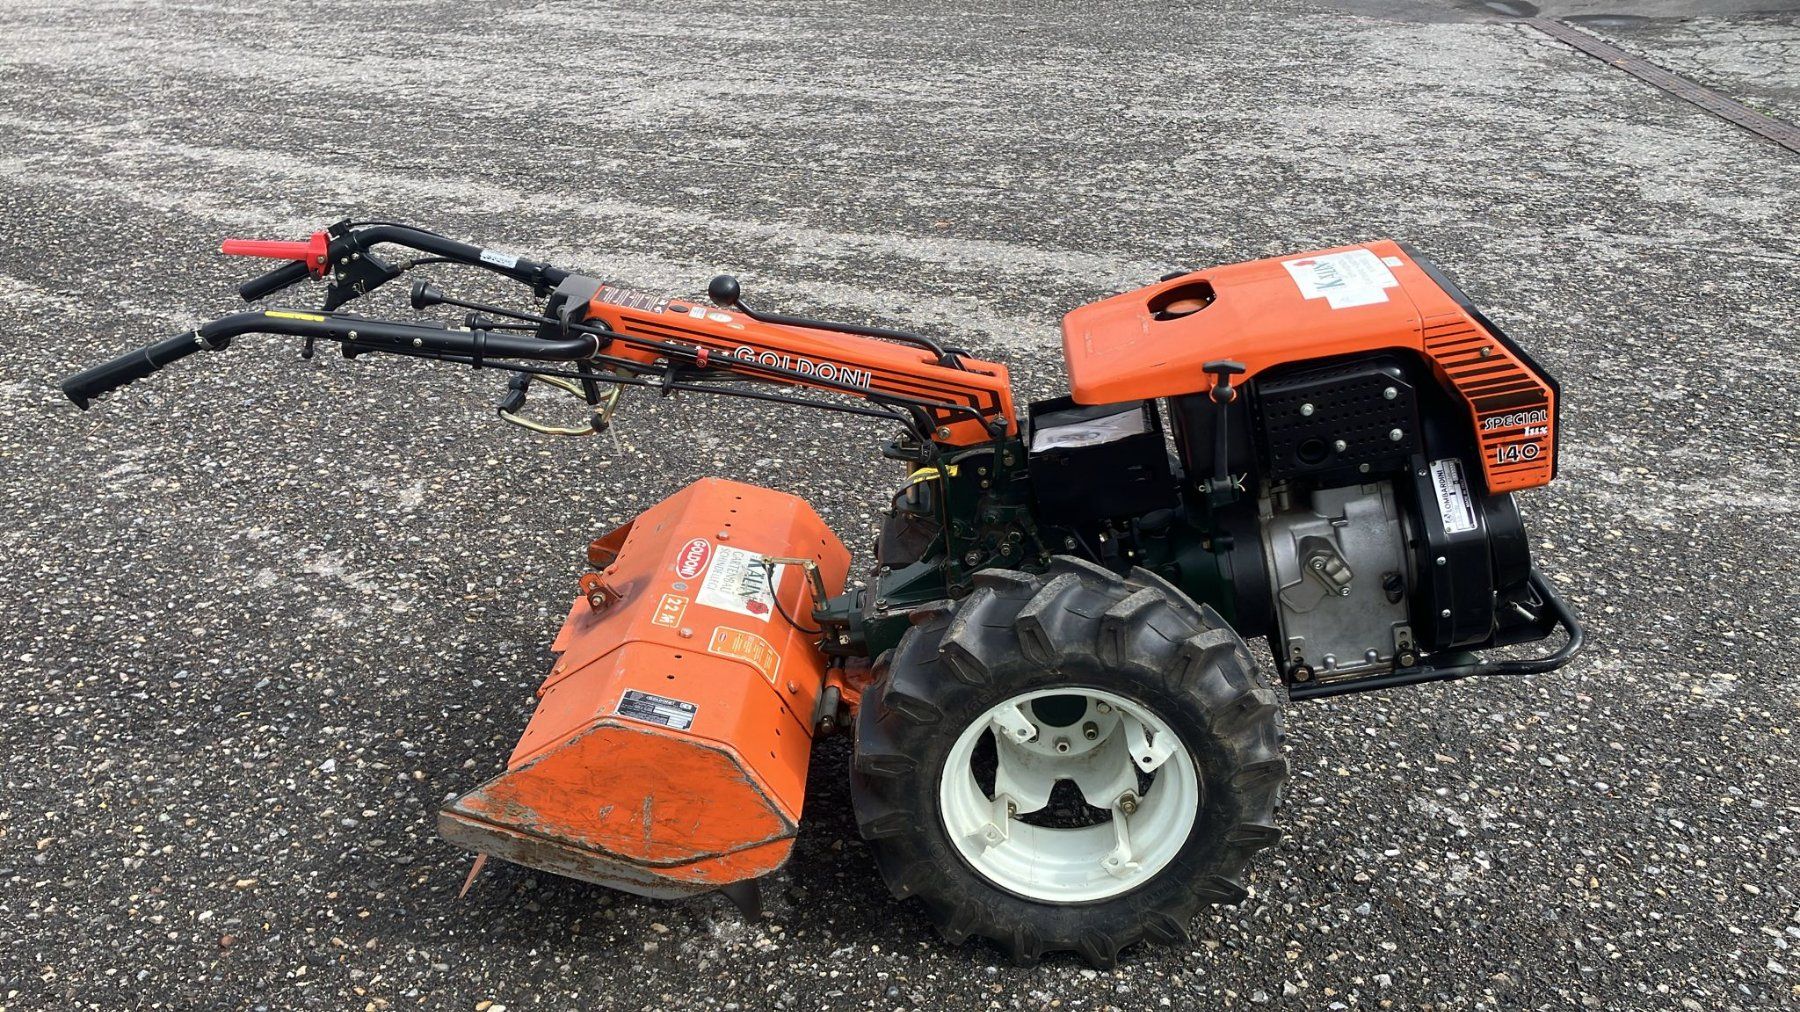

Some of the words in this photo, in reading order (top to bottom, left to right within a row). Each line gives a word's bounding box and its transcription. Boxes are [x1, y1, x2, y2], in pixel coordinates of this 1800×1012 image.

[733, 345, 872, 390] GOLDONI
[1484, 409, 1548, 431] SPECIAL
[1524, 425, 1549, 436] lux
[1496, 442, 1540, 464] 140
[1436, 469, 1453, 514] LOMBARDINI
[680, 540, 707, 576] GOLDONI
[664, 597, 682, 612] 22
